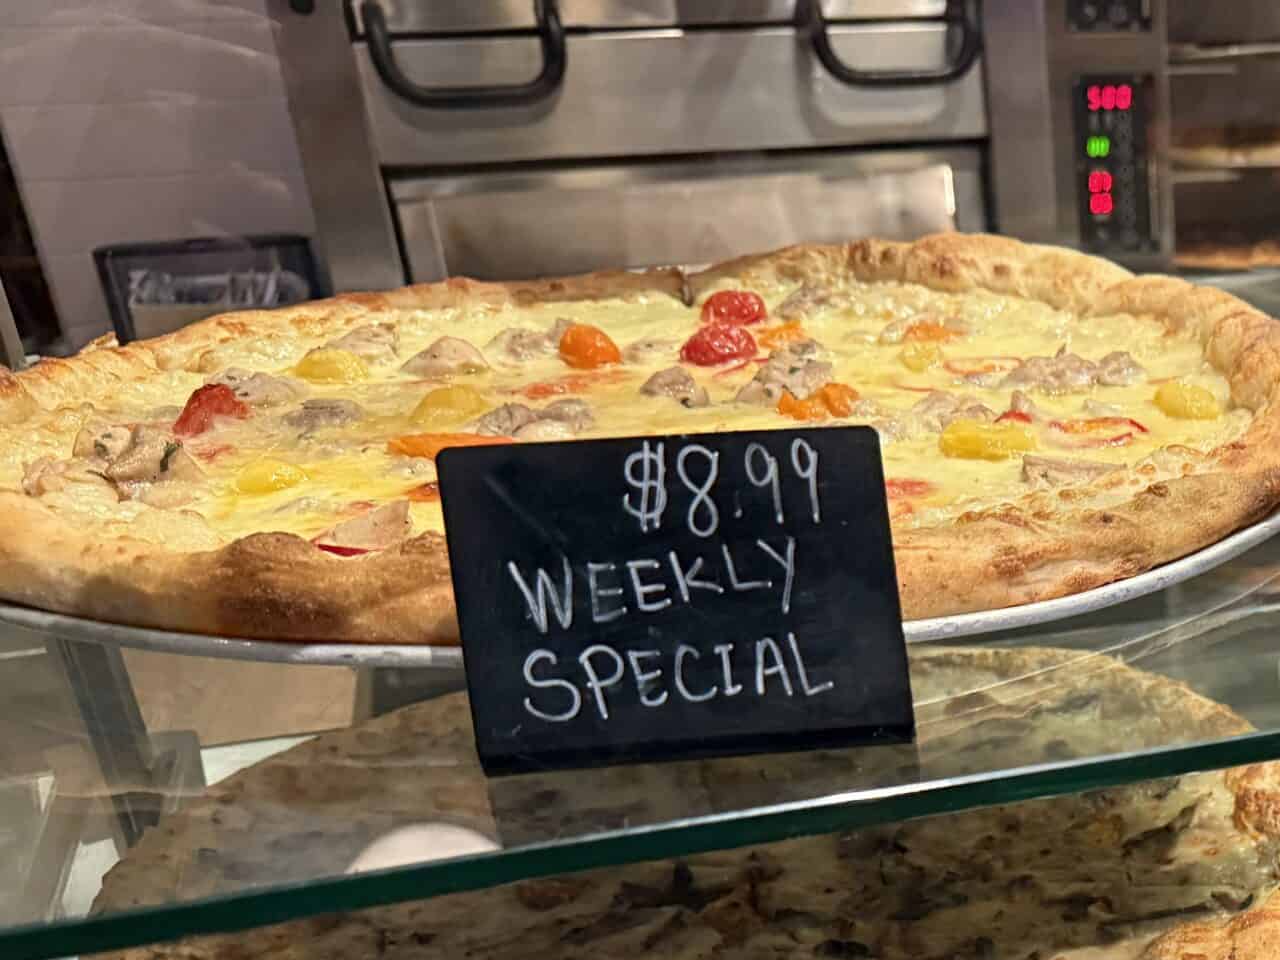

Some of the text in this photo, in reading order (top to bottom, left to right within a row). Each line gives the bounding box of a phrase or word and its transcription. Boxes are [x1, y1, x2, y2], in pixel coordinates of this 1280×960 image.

[624, 438, 822, 536] $8.99
[508, 537, 797, 633] WEEKLY
[523, 632, 834, 722] SPECIAL
